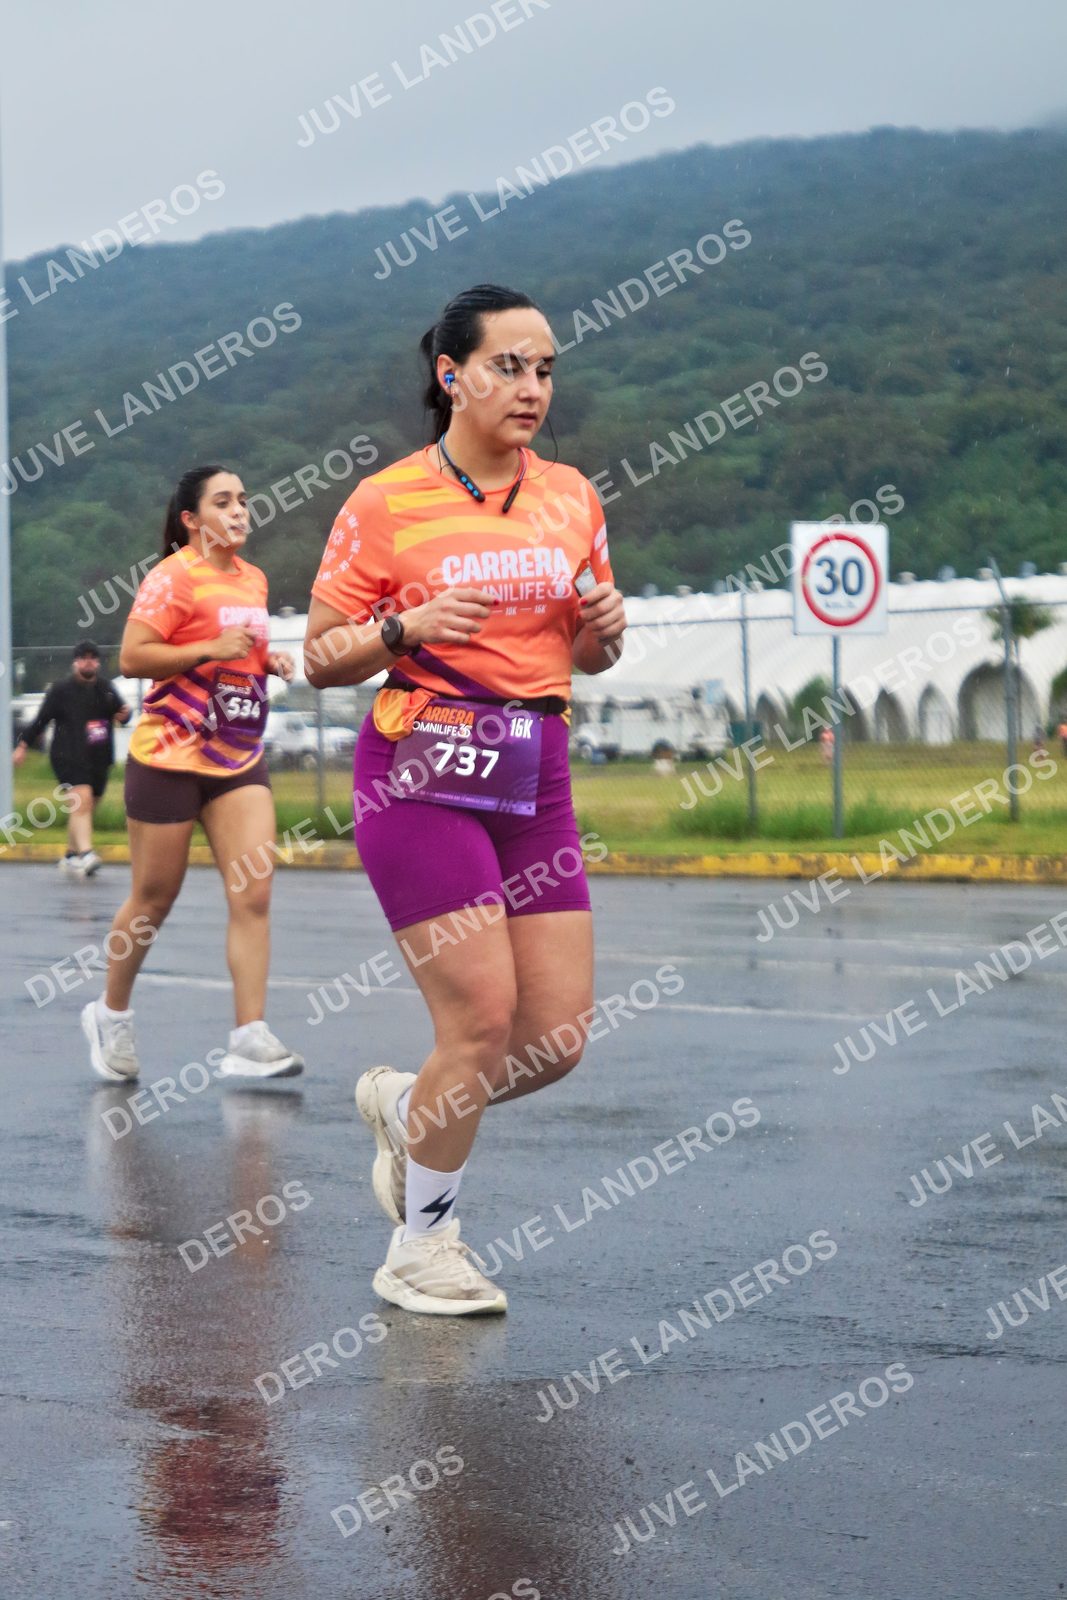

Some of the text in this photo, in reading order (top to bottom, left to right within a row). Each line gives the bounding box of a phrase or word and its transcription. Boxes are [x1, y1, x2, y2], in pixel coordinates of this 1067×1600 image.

[442, 546, 573, 585] CARRERA
[815, 555, 865, 596] 30
[481, 581, 546, 602] NILIFE
[412, 720, 458, 736] OMNILIFE
[419, 705, 475, 725] ARRERA
[434, 741, 500, 779] 737
